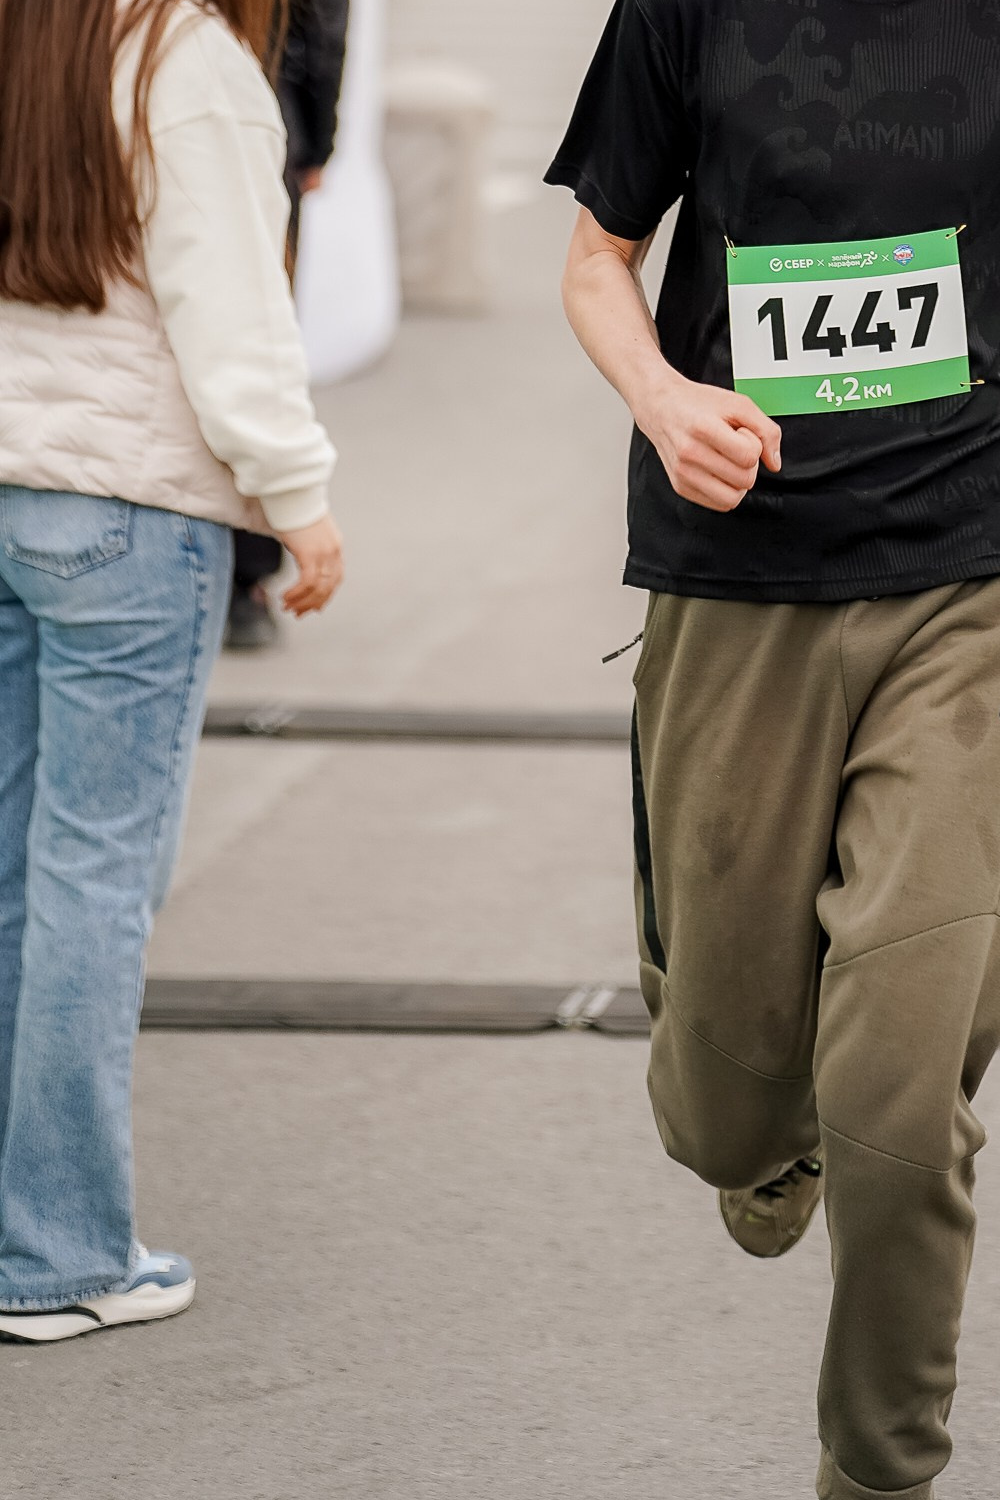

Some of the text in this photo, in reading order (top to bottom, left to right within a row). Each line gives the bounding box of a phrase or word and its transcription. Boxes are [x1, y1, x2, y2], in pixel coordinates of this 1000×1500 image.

[832, 120, 945, 162] ARMANI
[784, 258, 814, 270] СБЕР
[757, 282, 939, 361] 1447
